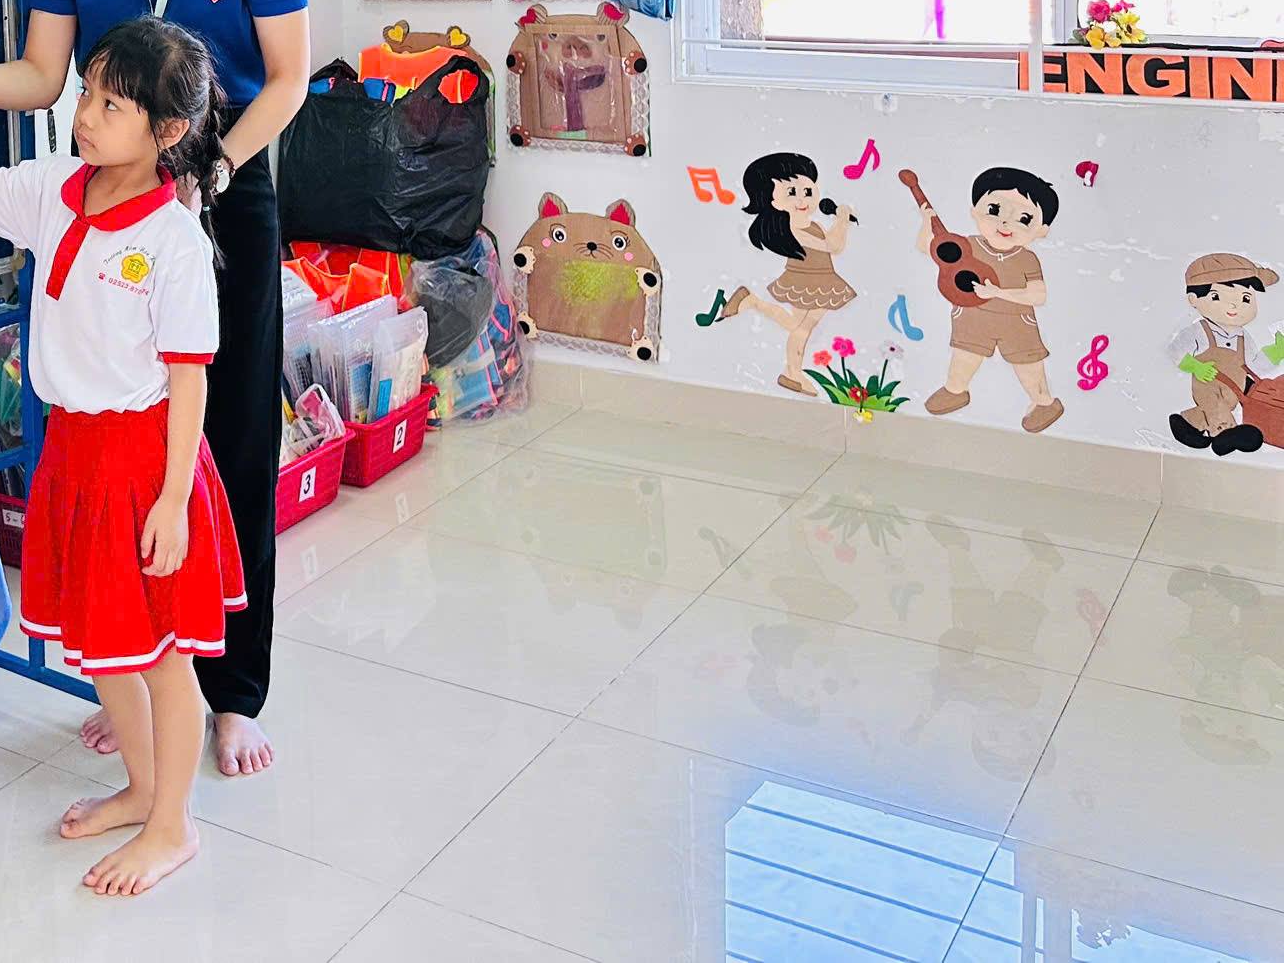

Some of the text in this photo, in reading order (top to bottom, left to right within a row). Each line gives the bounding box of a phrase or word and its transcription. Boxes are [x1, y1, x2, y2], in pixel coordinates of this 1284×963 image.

[1018, 52, 1284, 102] ENGIN
[397, 427, 403, 445] 2
[304, 474, 311, 494] 3
